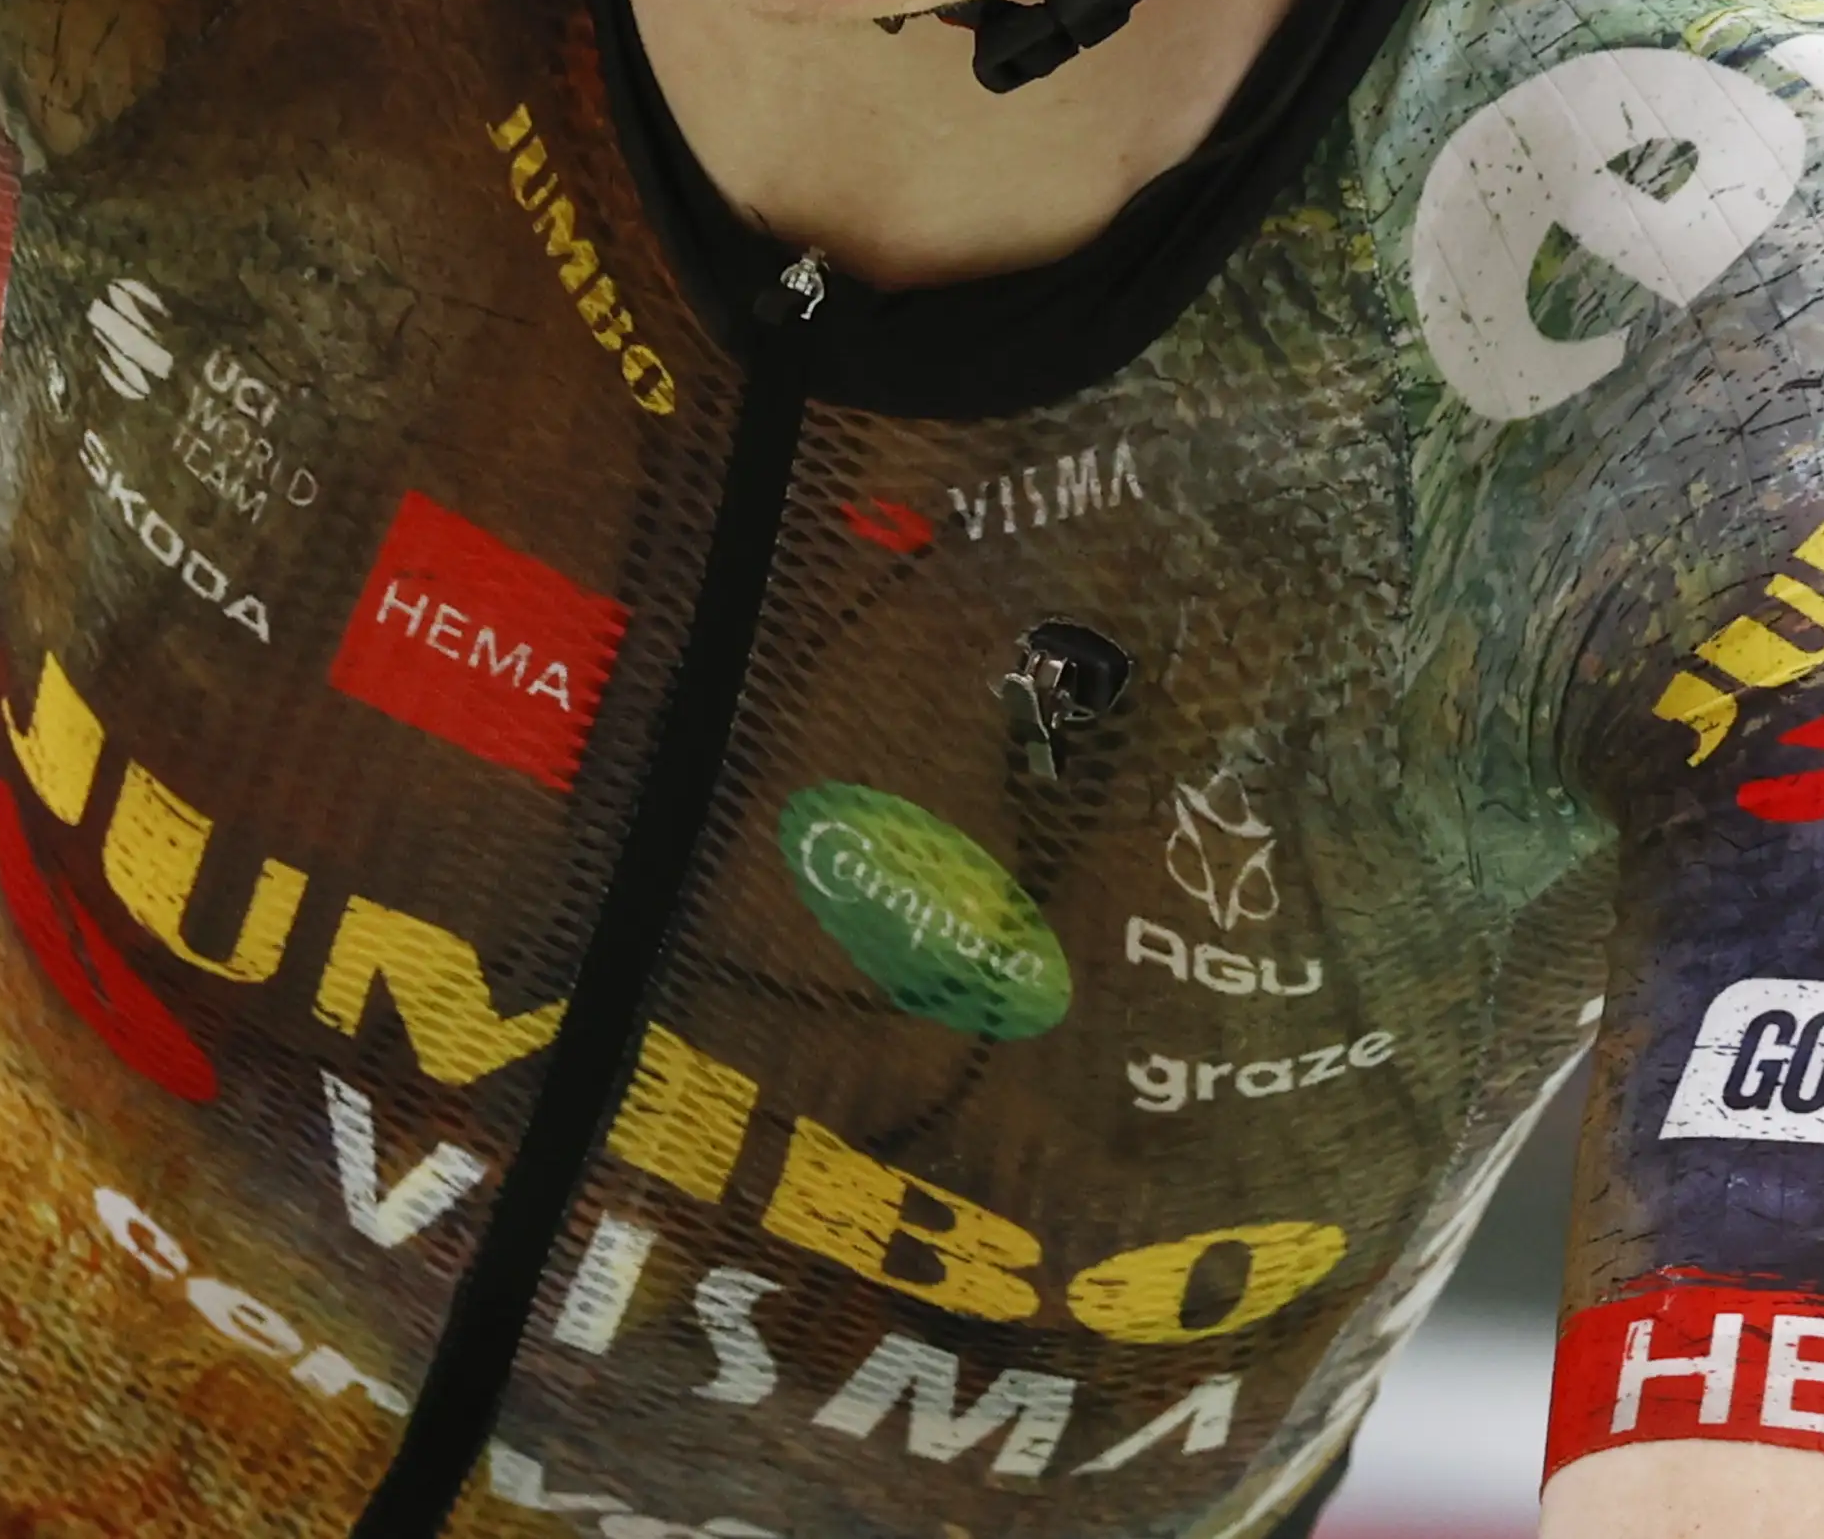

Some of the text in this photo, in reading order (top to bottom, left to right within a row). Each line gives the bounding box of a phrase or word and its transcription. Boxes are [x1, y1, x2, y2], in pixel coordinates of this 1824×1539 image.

[486, 102, 676, 416] JUMBO
[204, 349, 279, 428] UCI
[948, 439, 1143, 541] VISMA
[376, 580, 572, 712] HEMA
[1, 651, 1347, 1345] JUMBO
[1125, 916, 1323, 996] AGU
[1126, 1029, 1397, 1114] graze
[319, 1068, 1241, 1478] VISMA
